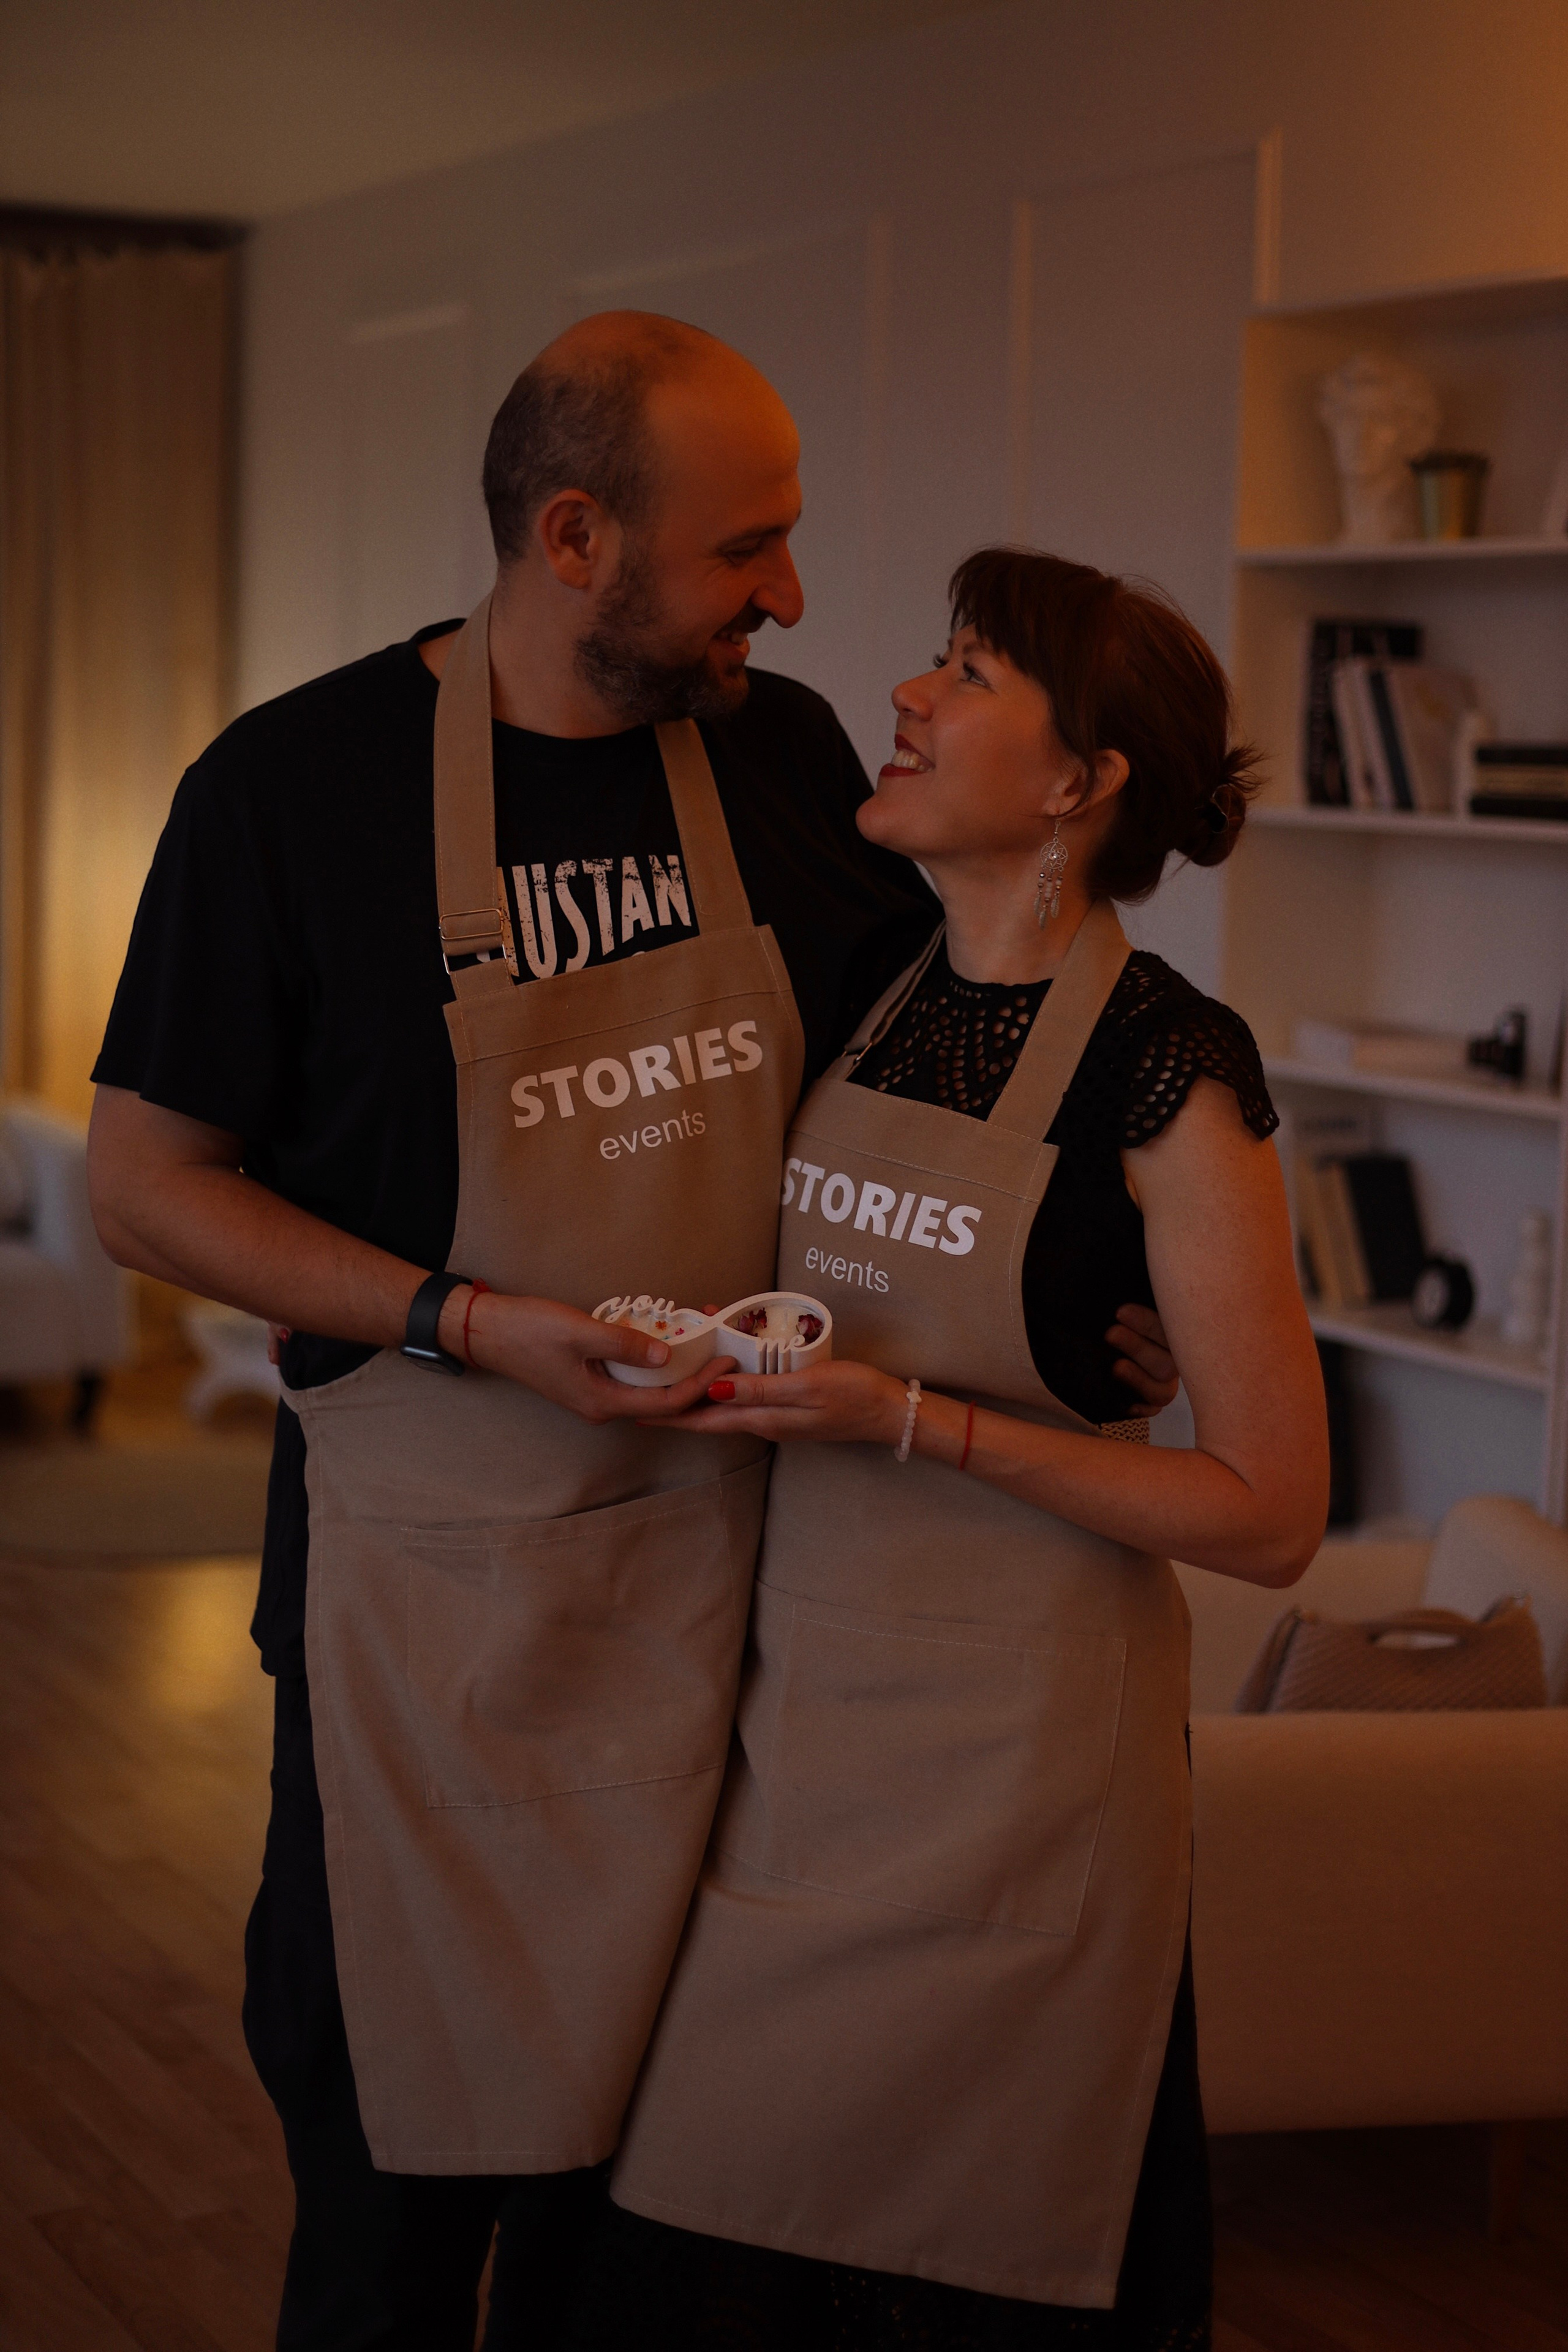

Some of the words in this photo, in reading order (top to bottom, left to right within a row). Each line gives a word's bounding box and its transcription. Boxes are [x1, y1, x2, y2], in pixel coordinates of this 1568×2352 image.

[476, 855, 692, 980] USTAN
[510, 1020, 763, 1128] STORIES
[600, 1110, 706, 1160] events
[781, 1158, 982, 1256] STORIES
[805, 1247, 889, 1293] events
[604, 1294, 675, 1323] you
[756, 1335, 805, 1353] me
